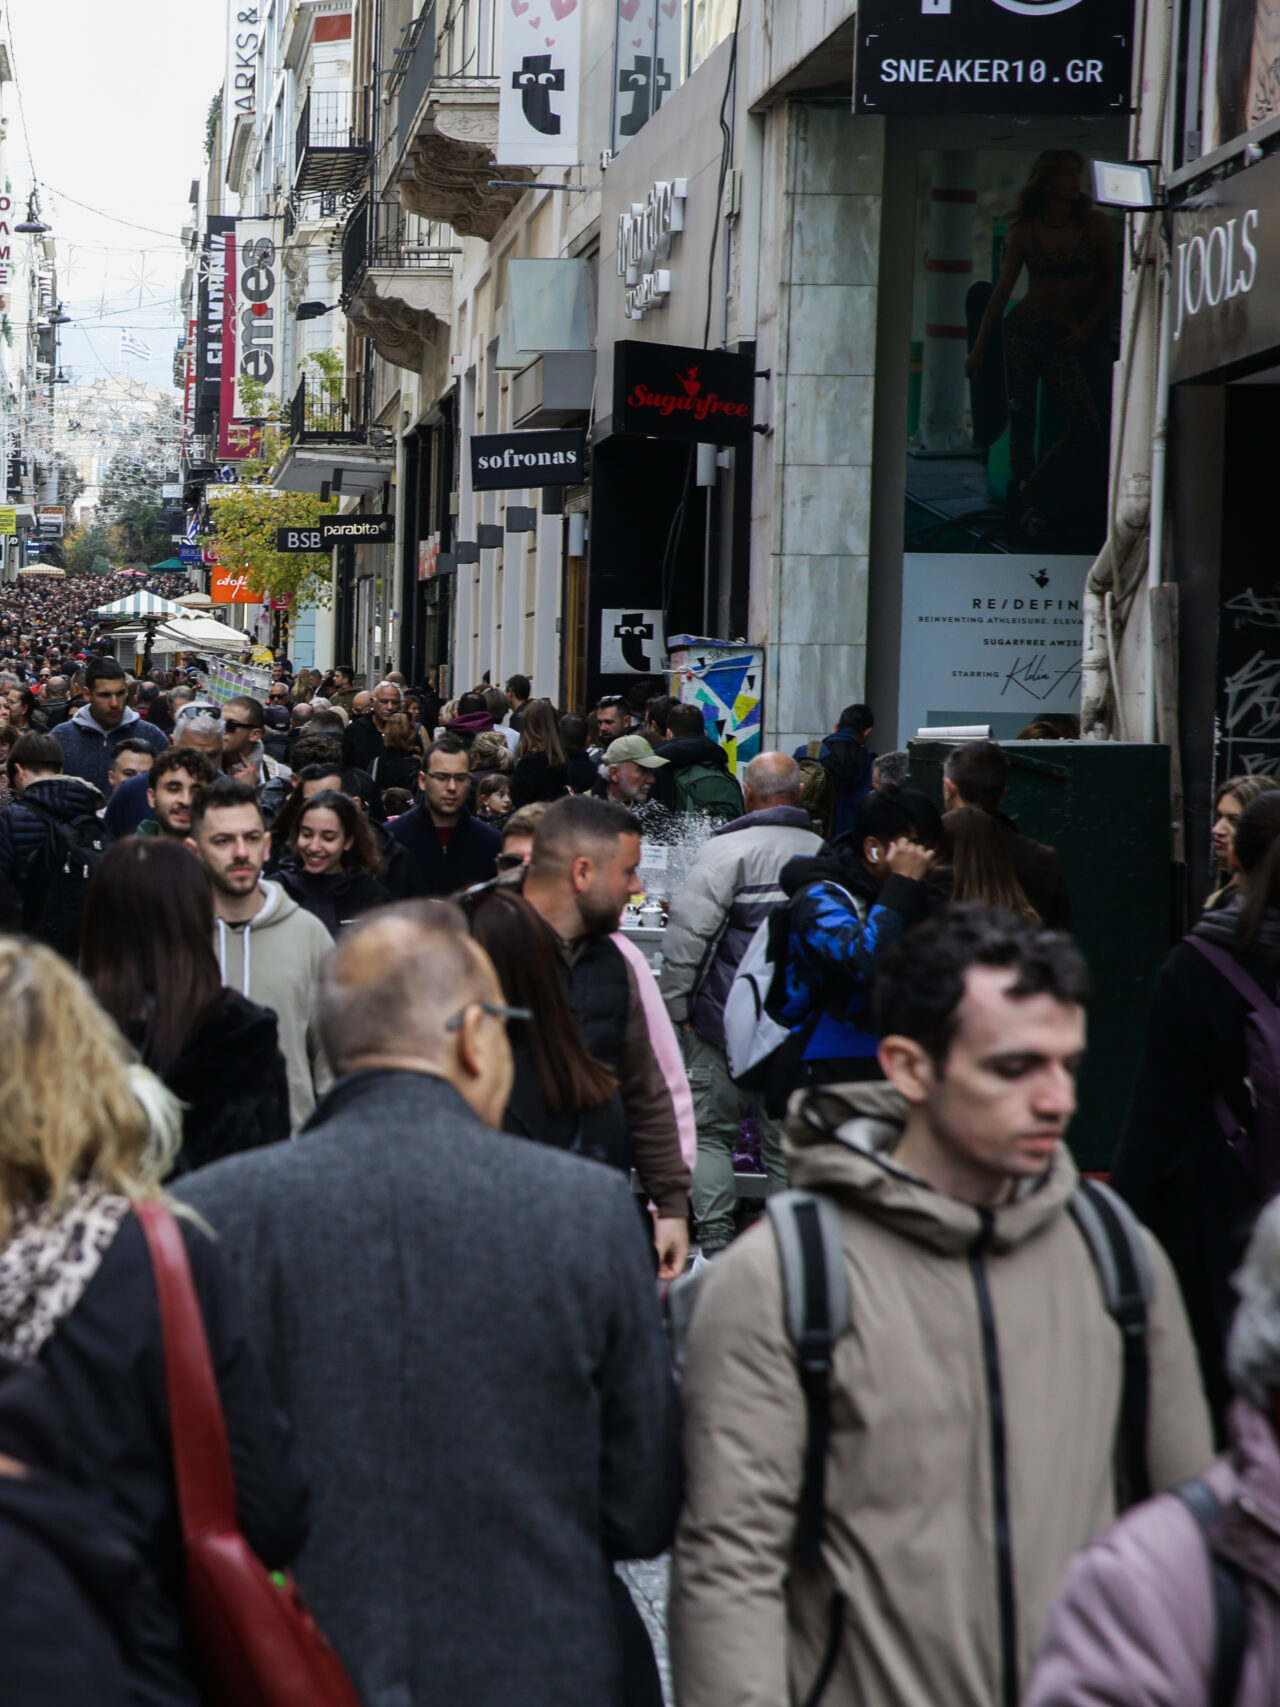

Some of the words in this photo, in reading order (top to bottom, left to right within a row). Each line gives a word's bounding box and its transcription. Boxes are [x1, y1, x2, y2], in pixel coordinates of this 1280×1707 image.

[880, 59, 1103, 83] SNEAKER10.GR
[627, 384, 749, 421] Sugarfree
[478, 448, 577, 470] sofronas
[324, 523, 380, 537] parabita
[287, 532, 322, 548] BSB
[918, 616, 984, 624] REINVENTING
[983, 638, 1046, 646] SUGARFREE
[951, 670, 1000, 678] STARRING
